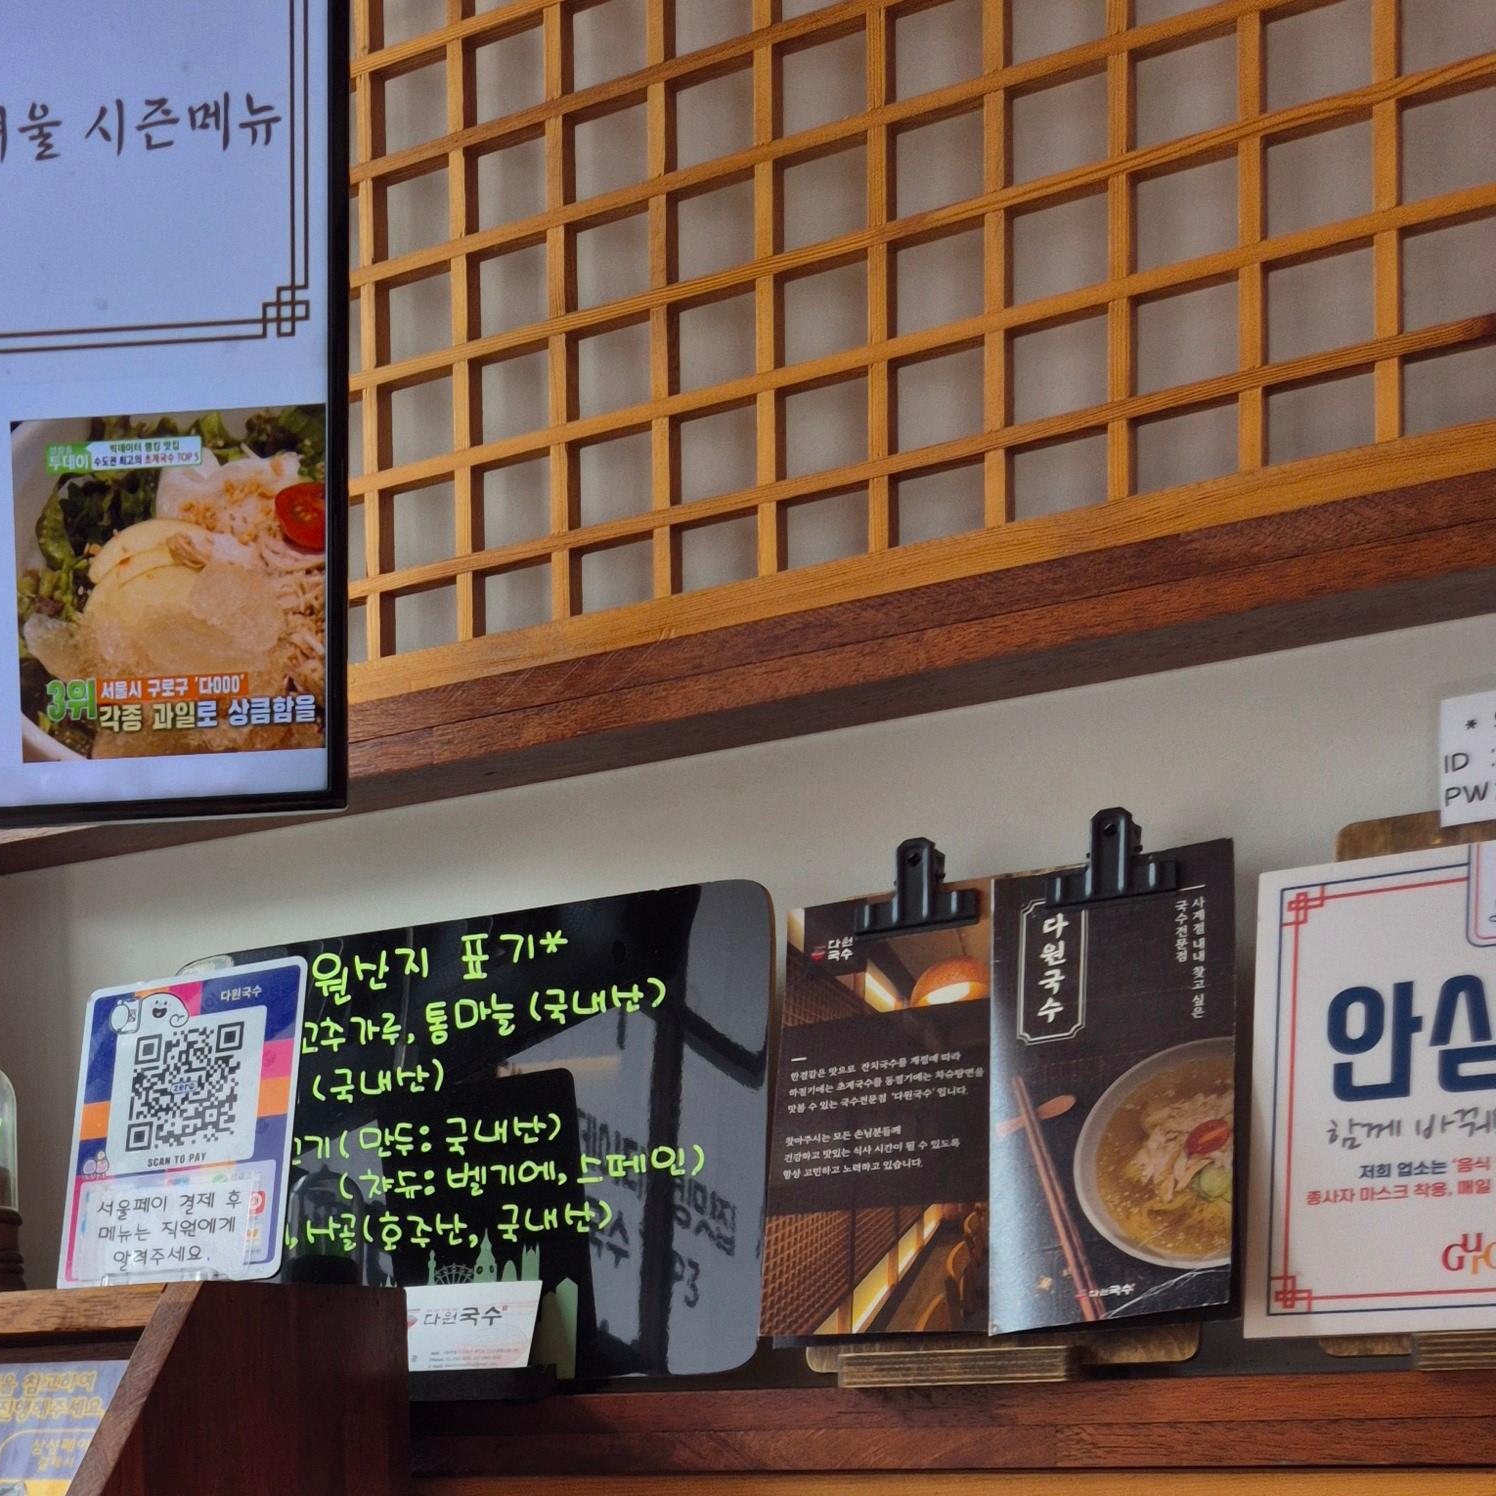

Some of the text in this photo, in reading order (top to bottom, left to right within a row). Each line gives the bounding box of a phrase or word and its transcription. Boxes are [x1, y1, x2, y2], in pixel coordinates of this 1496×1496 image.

[85, 91, 283, 158] 시즌메뉴
[164, 440, 180, 450] 맛집
[48, 453, 88, 470] 투데이
[119, 454, 142, 465] 최고의
[177, 452, 192, 463] TOP
[194, 452, 200, 463] 5
[46, 678, 96, 722] 3위
[100, 677, 189, 699] 서울시 구로구
[99, 695, 316, 732] 각종 과일로 상큼함을
[1444, 752, 1470, 773] ID
[1444, 781, 1489, 807] PW
[312, 948, 429, 1005] 원산지
[1037, 912, 1070, 1024] 다원국수
[220, 984, 263, 1002] 다원국수
[312, 1058, 444, 1103] (국내산)
[808, 1102, 817, 1111] 수
[820, 1100, 838, 1110] 있는
[446, 1113, 561, 1146] 국내산)
[833, 1130, 851, 1141] 모든
[1327, 1117, 1402, 1150] 함께
[147, 1151, 207, 1168] SCAN TO PAY
[784, 1150, 820, 1163] 건강하고
[823, 1147, 850, 1159] 맛있는
[853, 1144, 872, 1155] 식사
[874, 1142, 903, 1153] 시간이
[918, 1140, 927, 1149] 수
[446, 1160, 568, 1196] 벨기에,
[578, 1144, 704, 1185] 스페인)
[804, 1165, 840, 1177] 고민하고
[883, 1157, 923, 1170] 있습니다.
[1359, 1163, 1391, 1179] 저희
[1397, 1160, 1447, 1177] 업소는
[97, 1189, 242, 1220] 서울페이 결제 후
[1306, 1179, 1491, 1206] 종사자 마스크 착용, 매일
[98, 1216, 236, 1243] 메뉴는 직원에게
[497, 1200, 613, 1241] 국내산)
[422, 1306, 503, 1327] 다원국수
